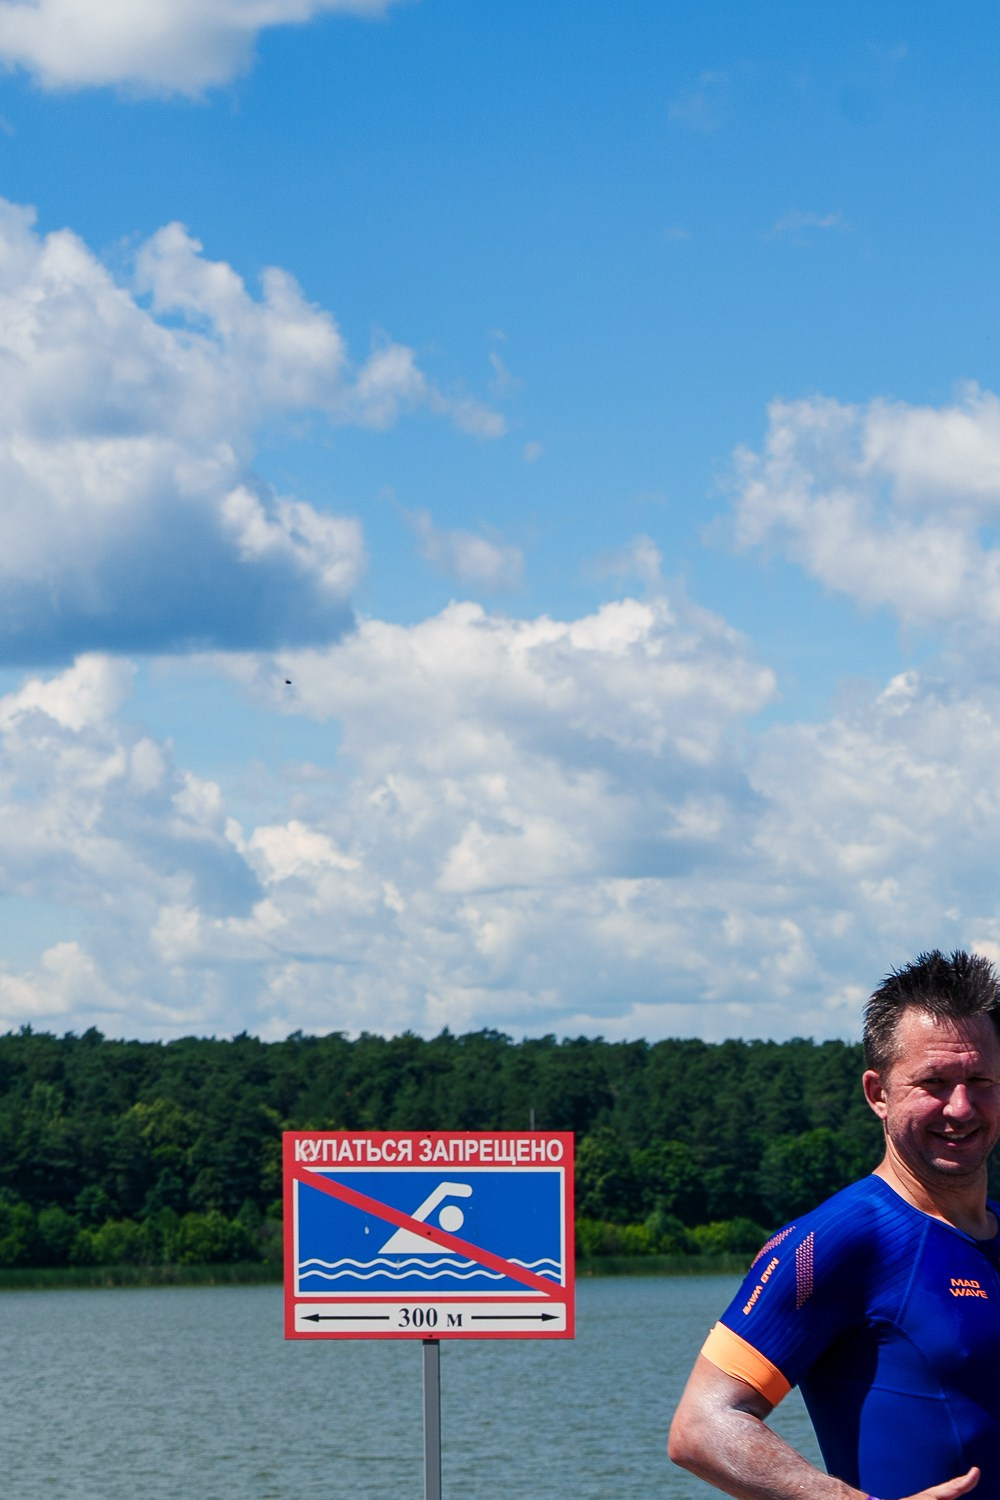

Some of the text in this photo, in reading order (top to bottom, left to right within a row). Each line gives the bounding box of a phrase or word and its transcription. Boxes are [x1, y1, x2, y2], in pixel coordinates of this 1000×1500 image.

[294, 1139, 564, 1166] КУПАТЬСЯ ЗАПРЕЩЕНО
[950, 1277, 981, 1289] MAD
[949, 1287, 989, 1300] WAVE
[397, 1307, 438, 1328] 300
